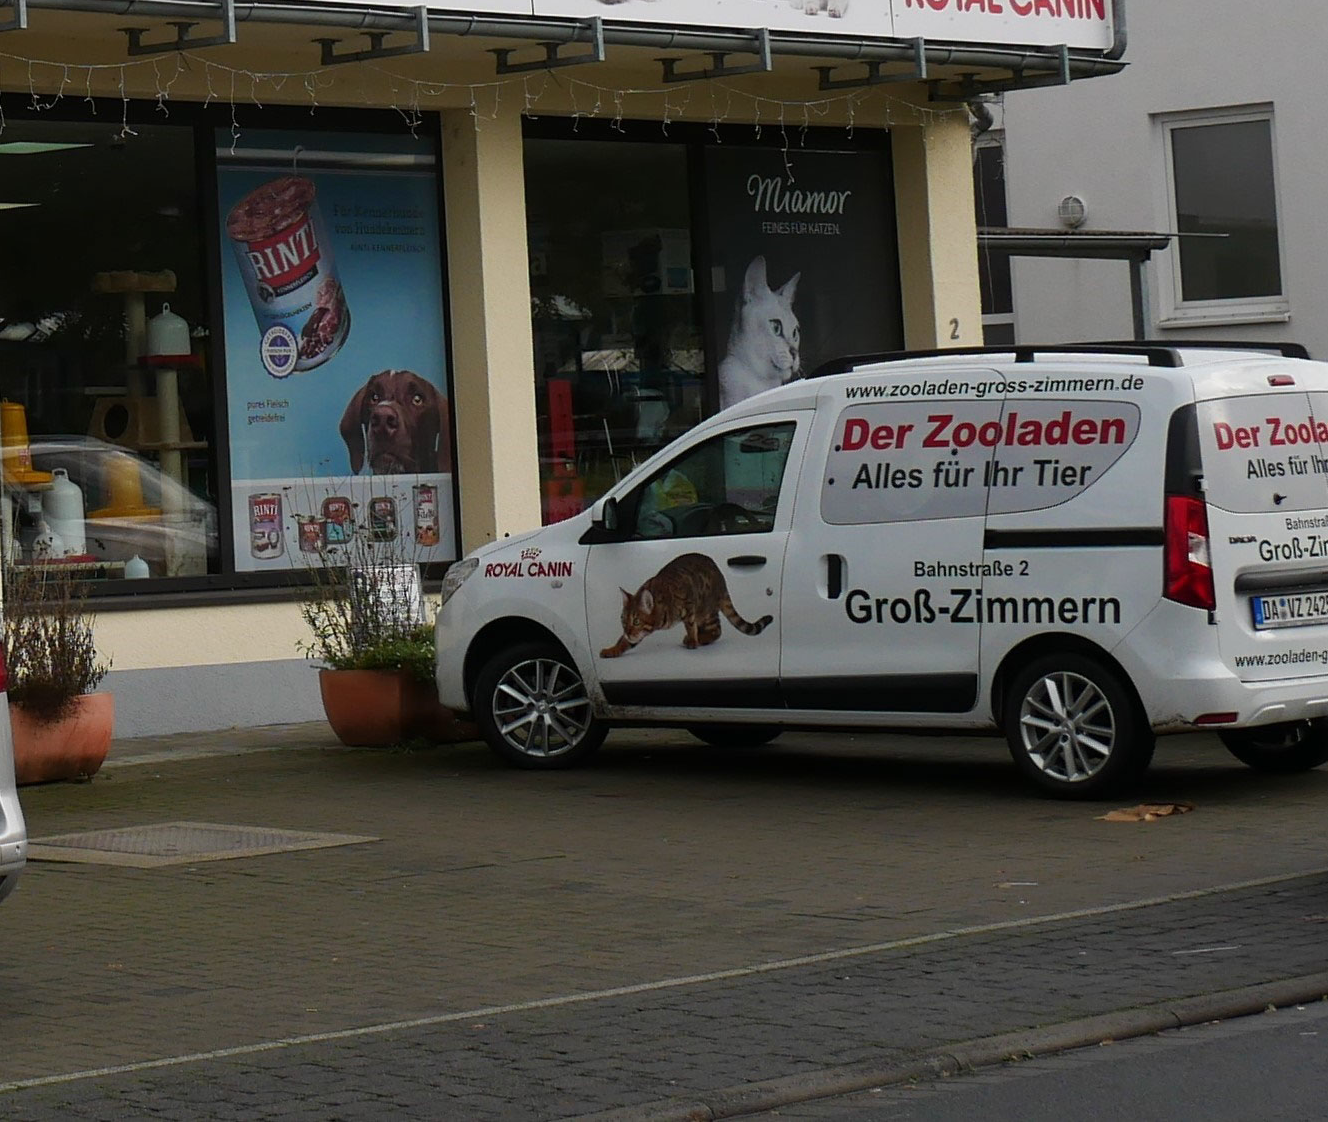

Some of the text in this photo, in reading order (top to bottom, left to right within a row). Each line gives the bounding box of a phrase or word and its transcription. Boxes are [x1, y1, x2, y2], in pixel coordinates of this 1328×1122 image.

[747, 174, 851, 215] Miamor
[247, 217, 320, 282] RINTI
[949, 318, 960, 340] 2
[845, 375, 1144, 399] www.zooladen-gross-zimmern.de
[841, 411, 1127, 452] Der Zooladen
[1213, 422, 1260, 451] Der
[852, 459, 1092, 490] Alles für Ihr Tier
[1247, 458, 1285, 479] Alles
[1288, 455, 1308, 475] für
[254, 504, 278, 517] RINTI
[484, 561, 573, 578] ROYAL CANIN
[914, 560, 1030, 577] Bahnstraße 2
[845, 588, 1122, 625] Groß-Zimmern
[1262, 599, 1280, 620] DA
[1287, 596, 1304, 618] VZ
